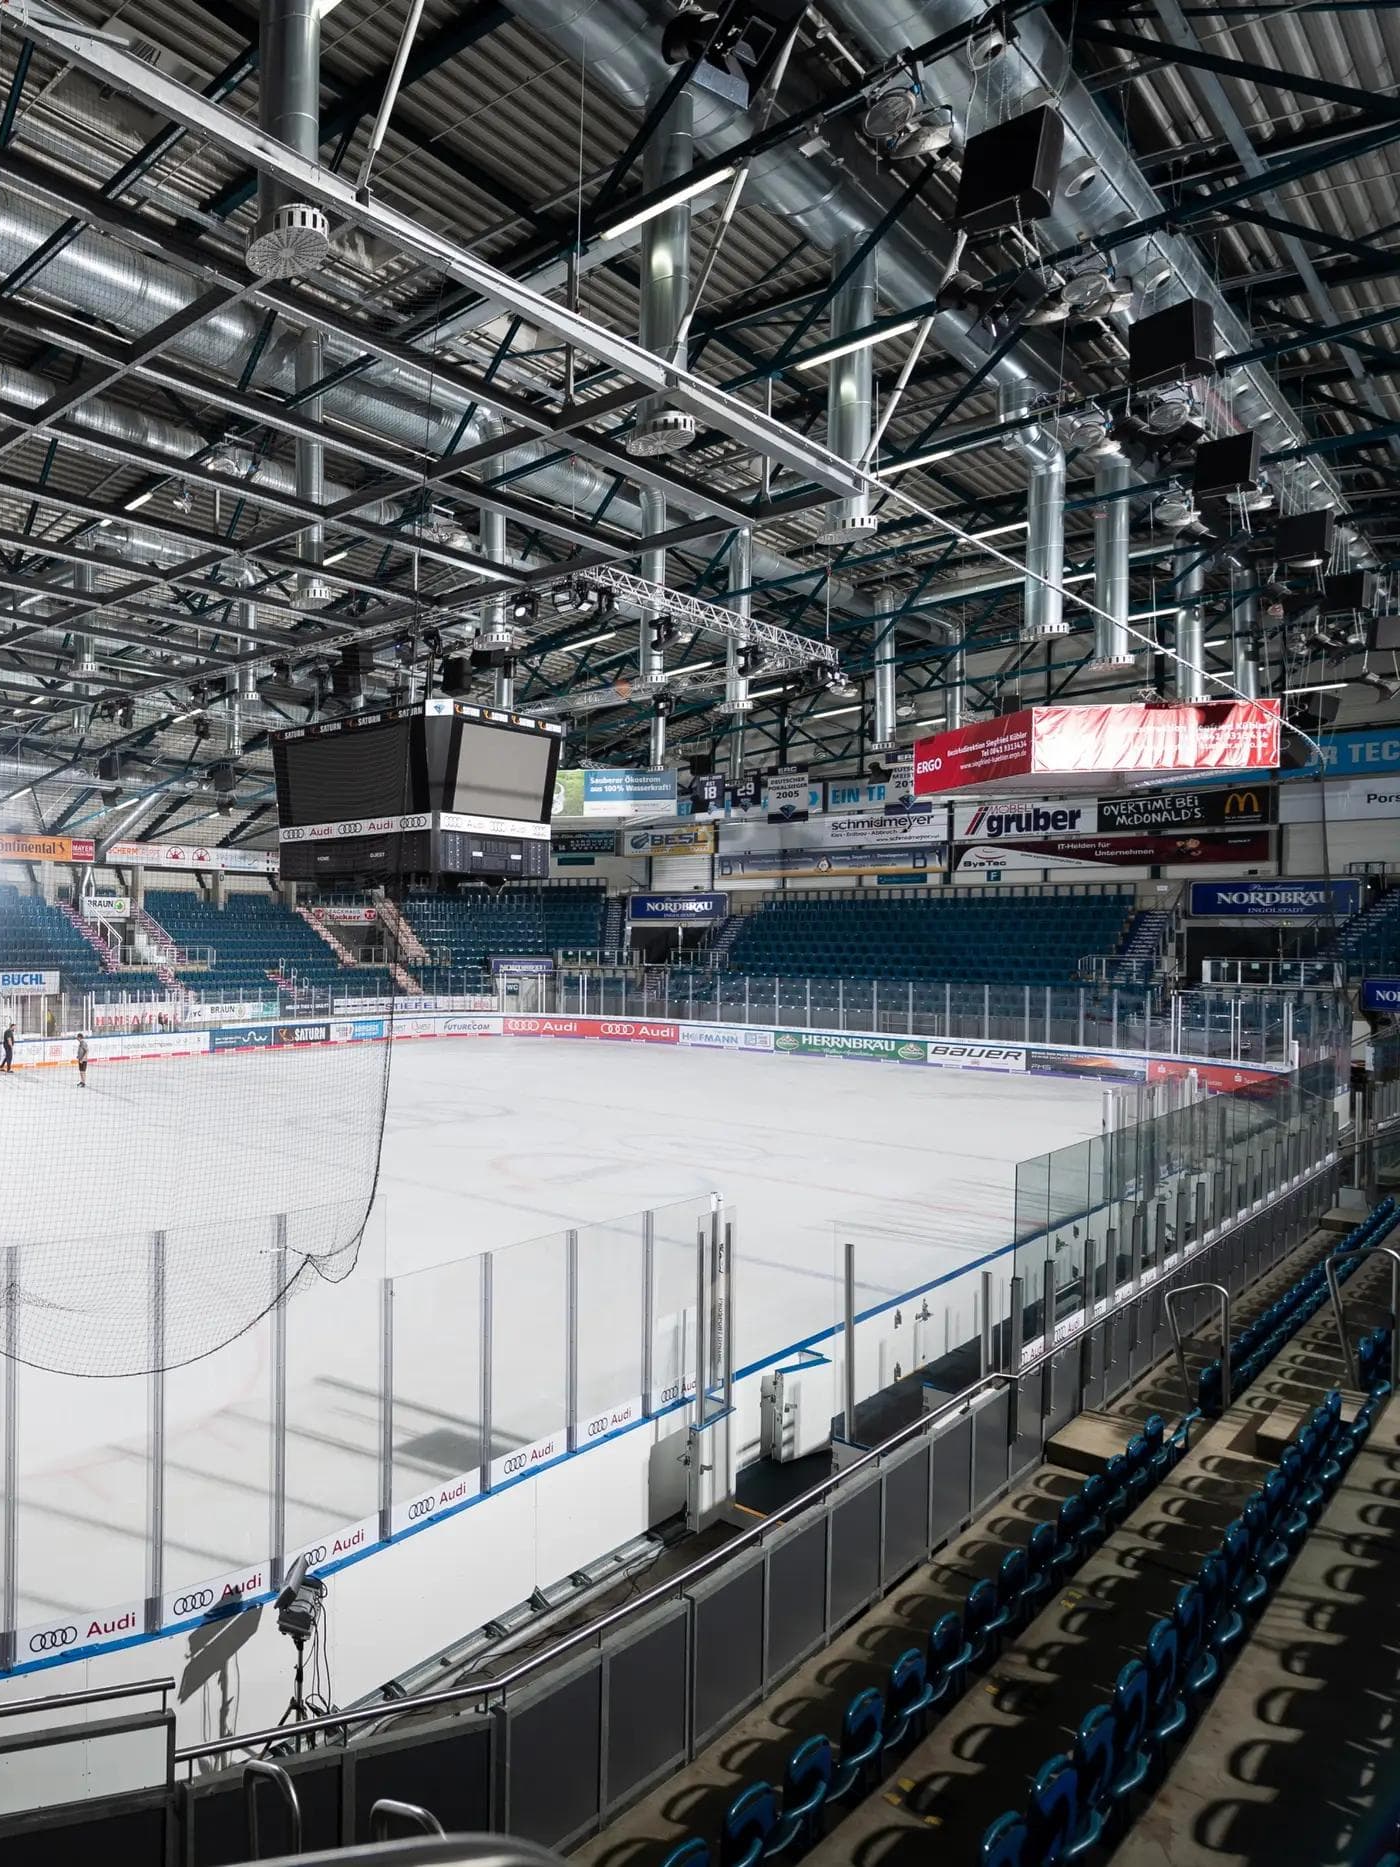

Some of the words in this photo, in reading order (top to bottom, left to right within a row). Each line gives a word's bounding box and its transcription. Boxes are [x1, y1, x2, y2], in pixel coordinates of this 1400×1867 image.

[285, 730, 305, 740] SATURN
[320, 723, 341, 733] SATURN
[358, 715, 381, 726] SATURN
[398, 707, 423, 718] SATURN
[917, 758, 942, 774] ERGO
[624, 774, 661, 783] Ökostrom
[604, 784, 625, 792] 100%
[704, 786, 717, 799] 18
[737, 782, 755, 796] 29
[776, 791, 799, 799] 2005
[832, 788, 859, 804] EIN
[309, 826, 333, 837] Audi
[368, 820, 393, 831] Audi
[832, 815, 934, 832] schmidmeyer
[987, 808, 1081, 837] gruber
[646, 901, 713, 912] NORDBRÄU
[1376, 990, 1400, 1001] NO
[211, 1006, 235, 1014] BRAUN
[385, 1001, 440, 1011] STIEFEL
[295, 1027, 325, 1042] SATURN
[543, 1021, 577, 1032] Audi
[639, 1025, 675, 1038] Audi
[802, 1034, 895, 1051] HERRNBRÄU
[611, 1406, 632, 1426] Audi
[530, 1442, 554, 1462] Audi
[439, 1482, 467, 1505] Audi
[332, 1529, 365, 1555] Audi
[221, 1574, 262, 1599] Audi
[86, 1613, 136, 1638] Audi
